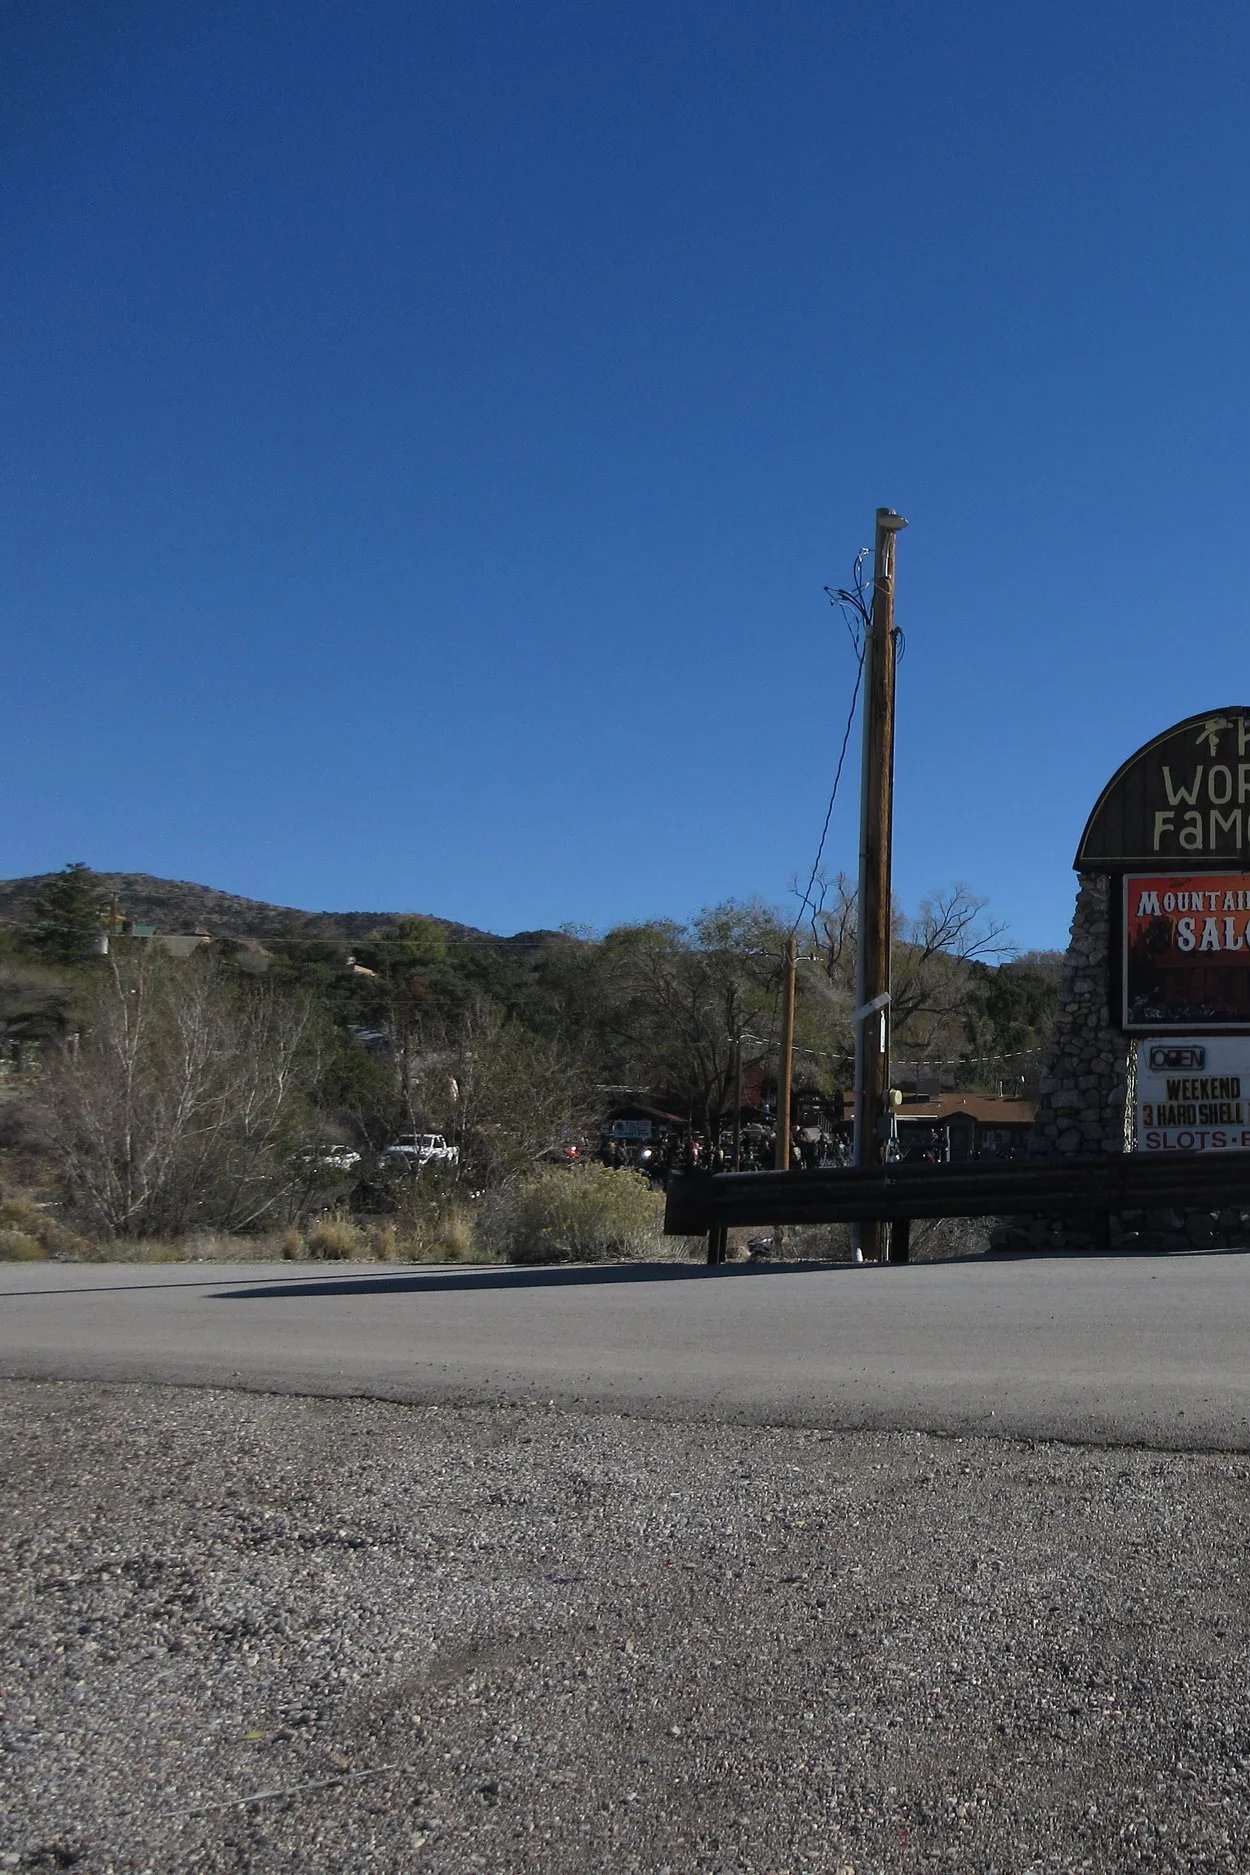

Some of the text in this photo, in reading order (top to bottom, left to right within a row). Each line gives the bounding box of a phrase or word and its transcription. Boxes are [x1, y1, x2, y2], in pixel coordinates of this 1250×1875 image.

[1166, 1076, 1241, 1101] WEEKEND
[1143, 1104, 1153, 1126] 3
[1145, 1131, 1228, 1151] SLOTS
